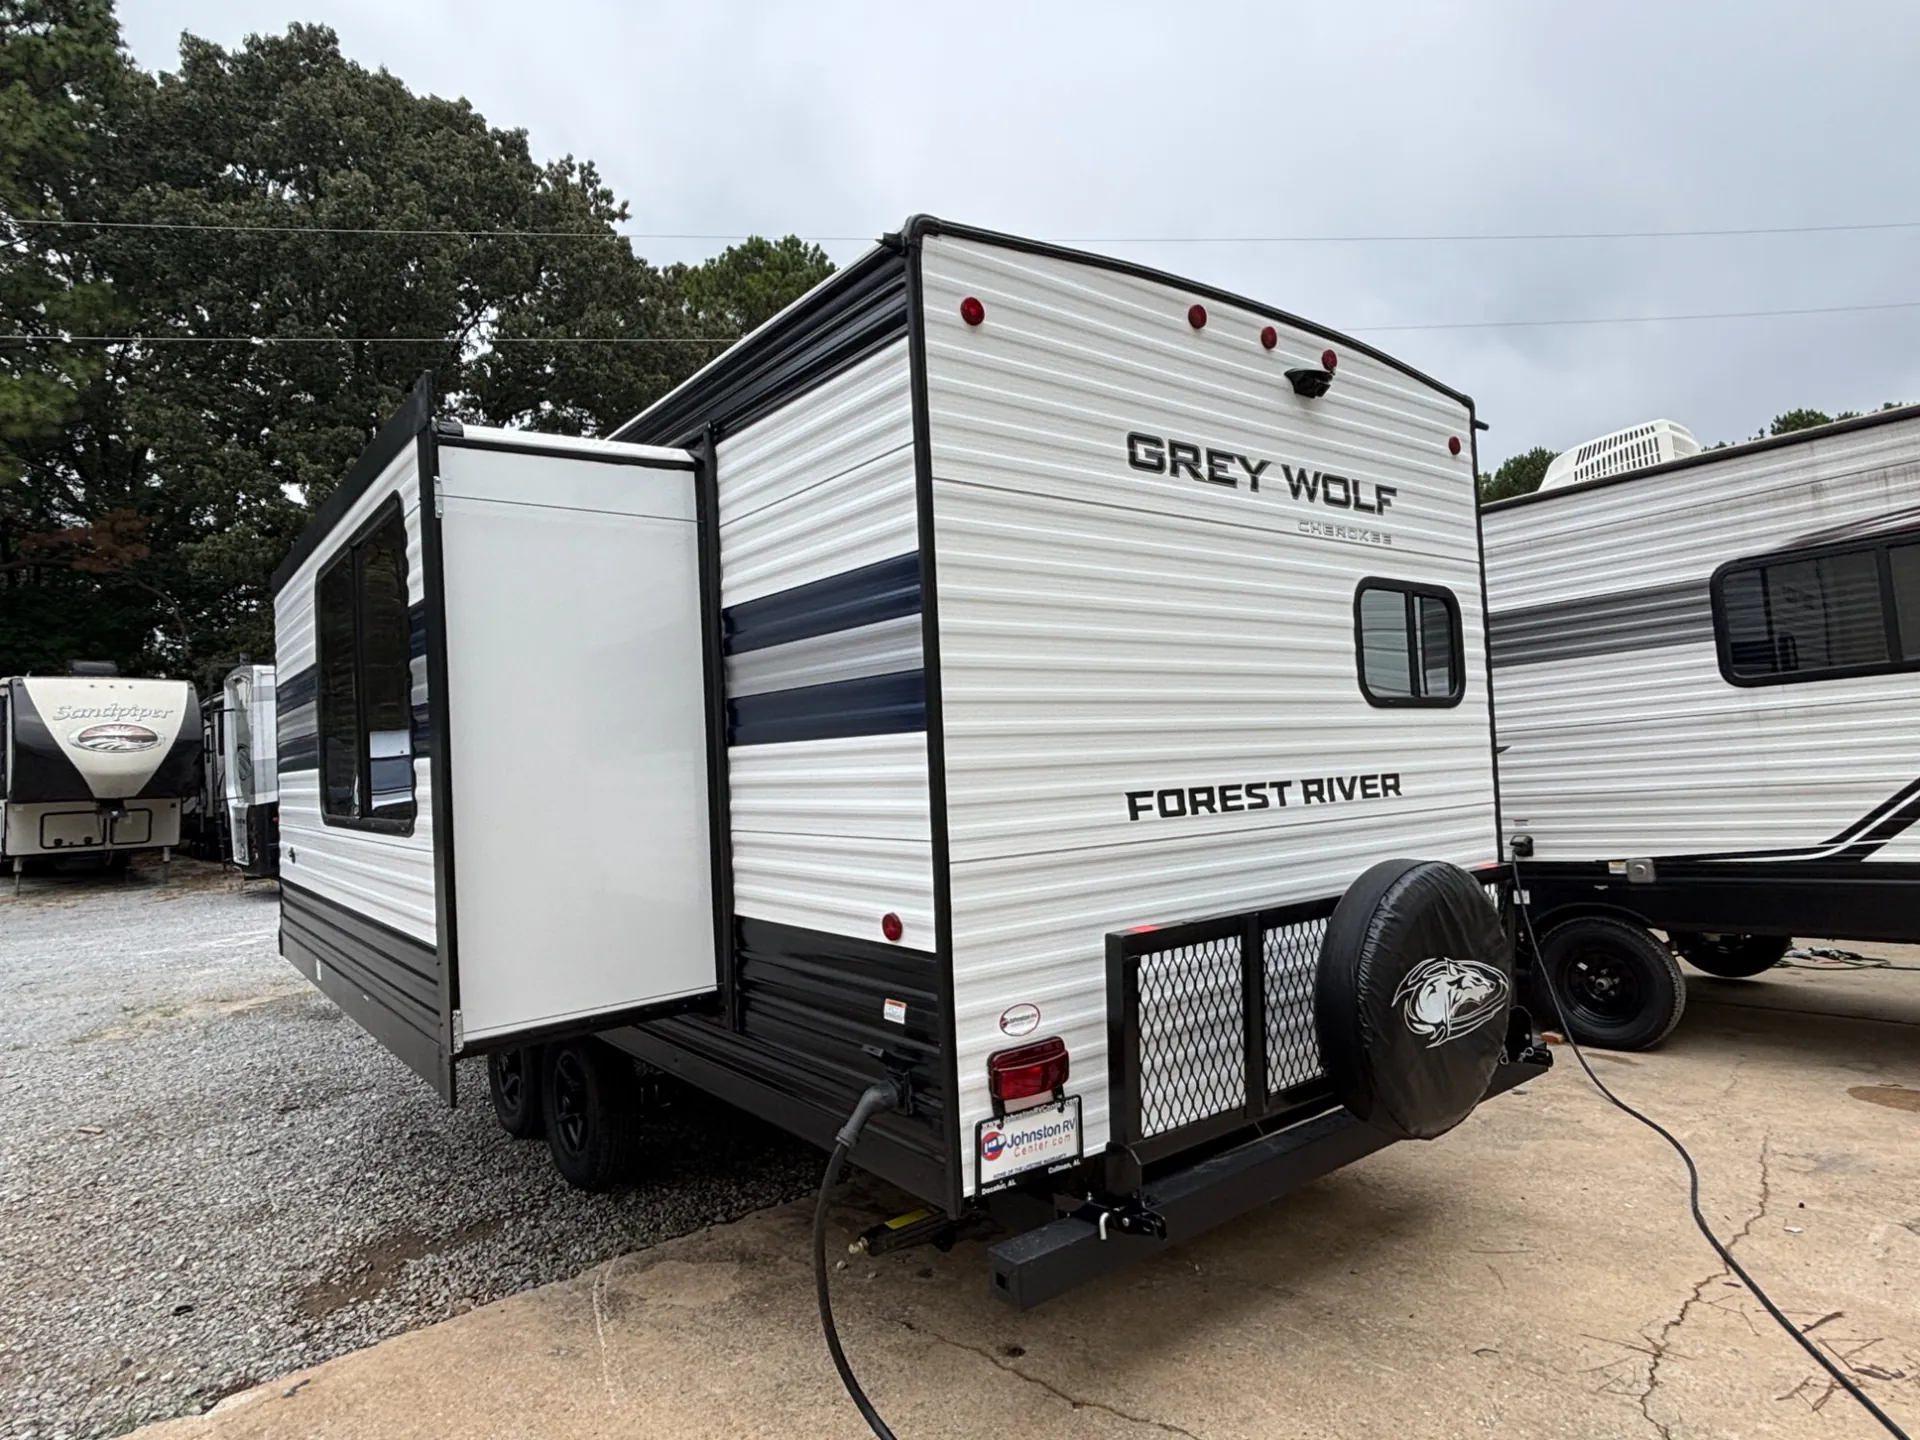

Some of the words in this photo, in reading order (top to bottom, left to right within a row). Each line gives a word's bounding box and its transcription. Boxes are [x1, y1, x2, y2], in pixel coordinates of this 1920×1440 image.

[1127, 431, 1272, 493] GREY
[1281, 464, 1397, 516] WOLF
[1297, 520, 1392, 545] CHEROKEE
[53, 702, 174, 721] Sandpiper
[1125, 780, 1292, 821] FOREST
[1300, 773, 1403, 805] RIVER
[1007, 1123, 1061, 1149] Johnston
[1063, 1118, 1076, 1133] RV
